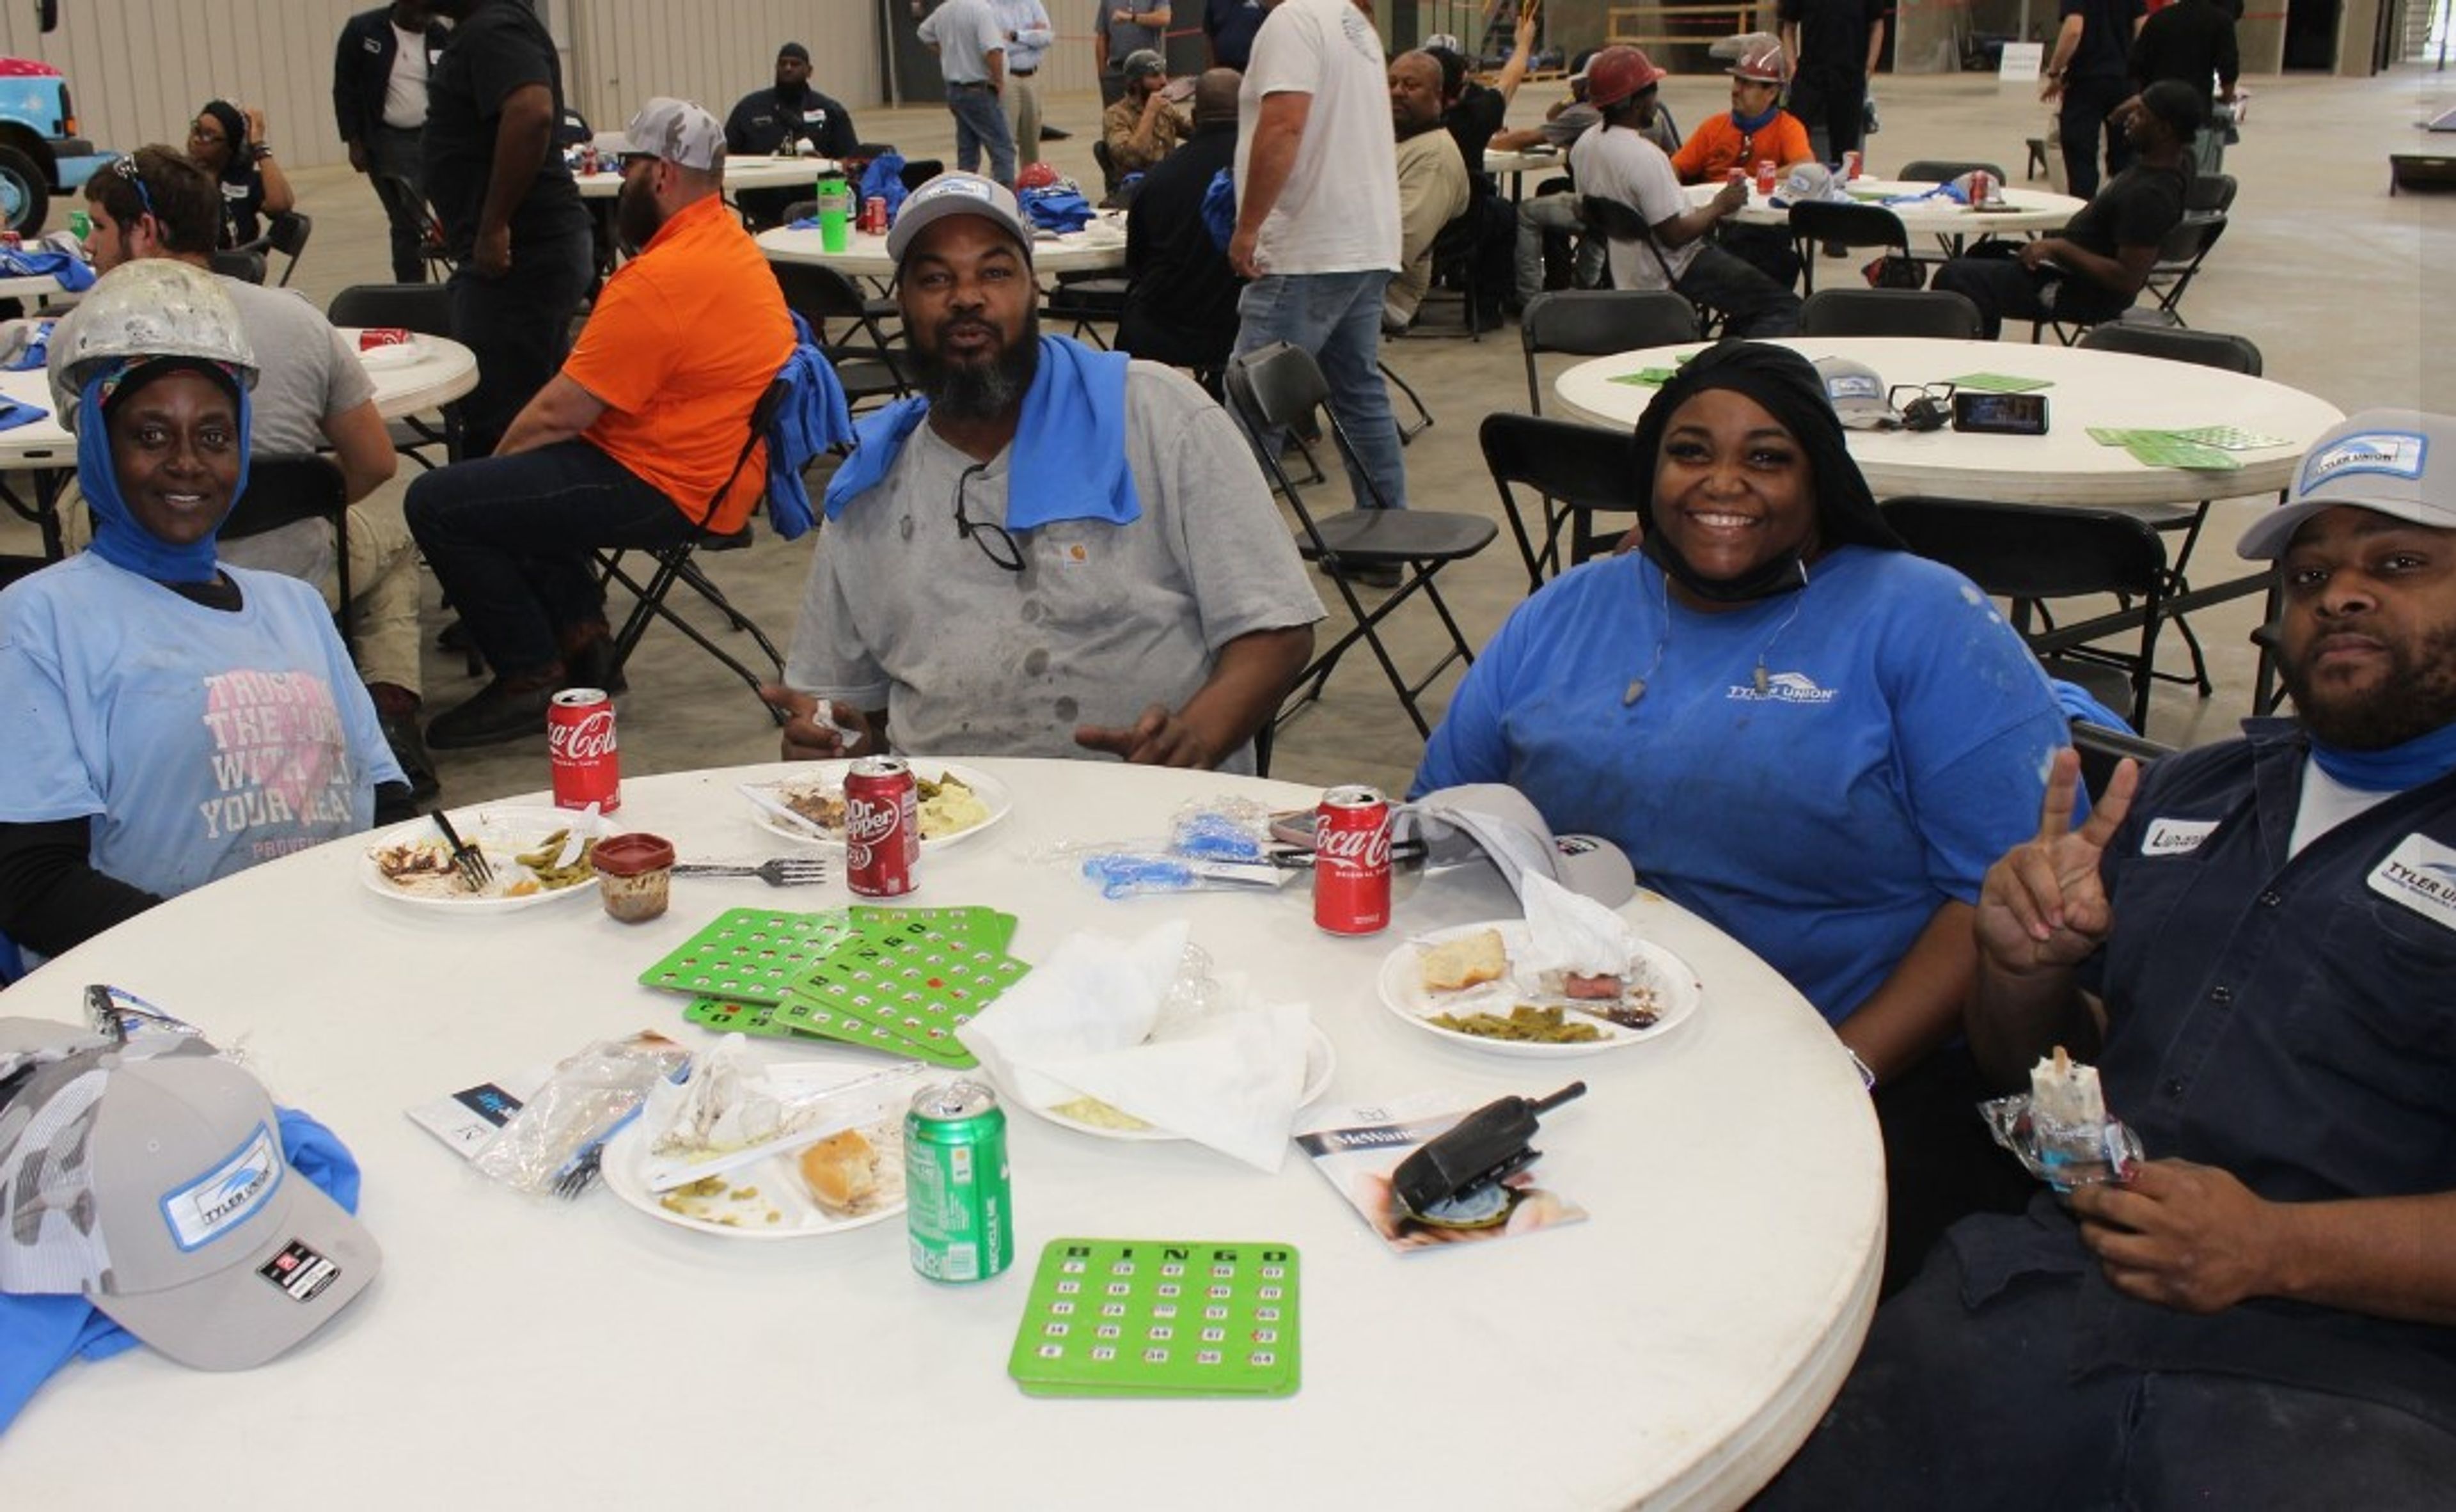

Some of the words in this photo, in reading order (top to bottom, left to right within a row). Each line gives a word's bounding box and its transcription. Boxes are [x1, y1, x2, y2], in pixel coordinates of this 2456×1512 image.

[203, 672, 310, 708] TRUST
[1783, 687, 1834, 699] UNION
[203, 707, 282, 749] THE
[199, 787, 293, 839] YOUR
[850, 799, 875, 819] Dr
[2389, 860, 2441, 894] TYLER
[204, 1192, 246, 1224] TYLER
[1163, 1248, 1189, 1260] N
